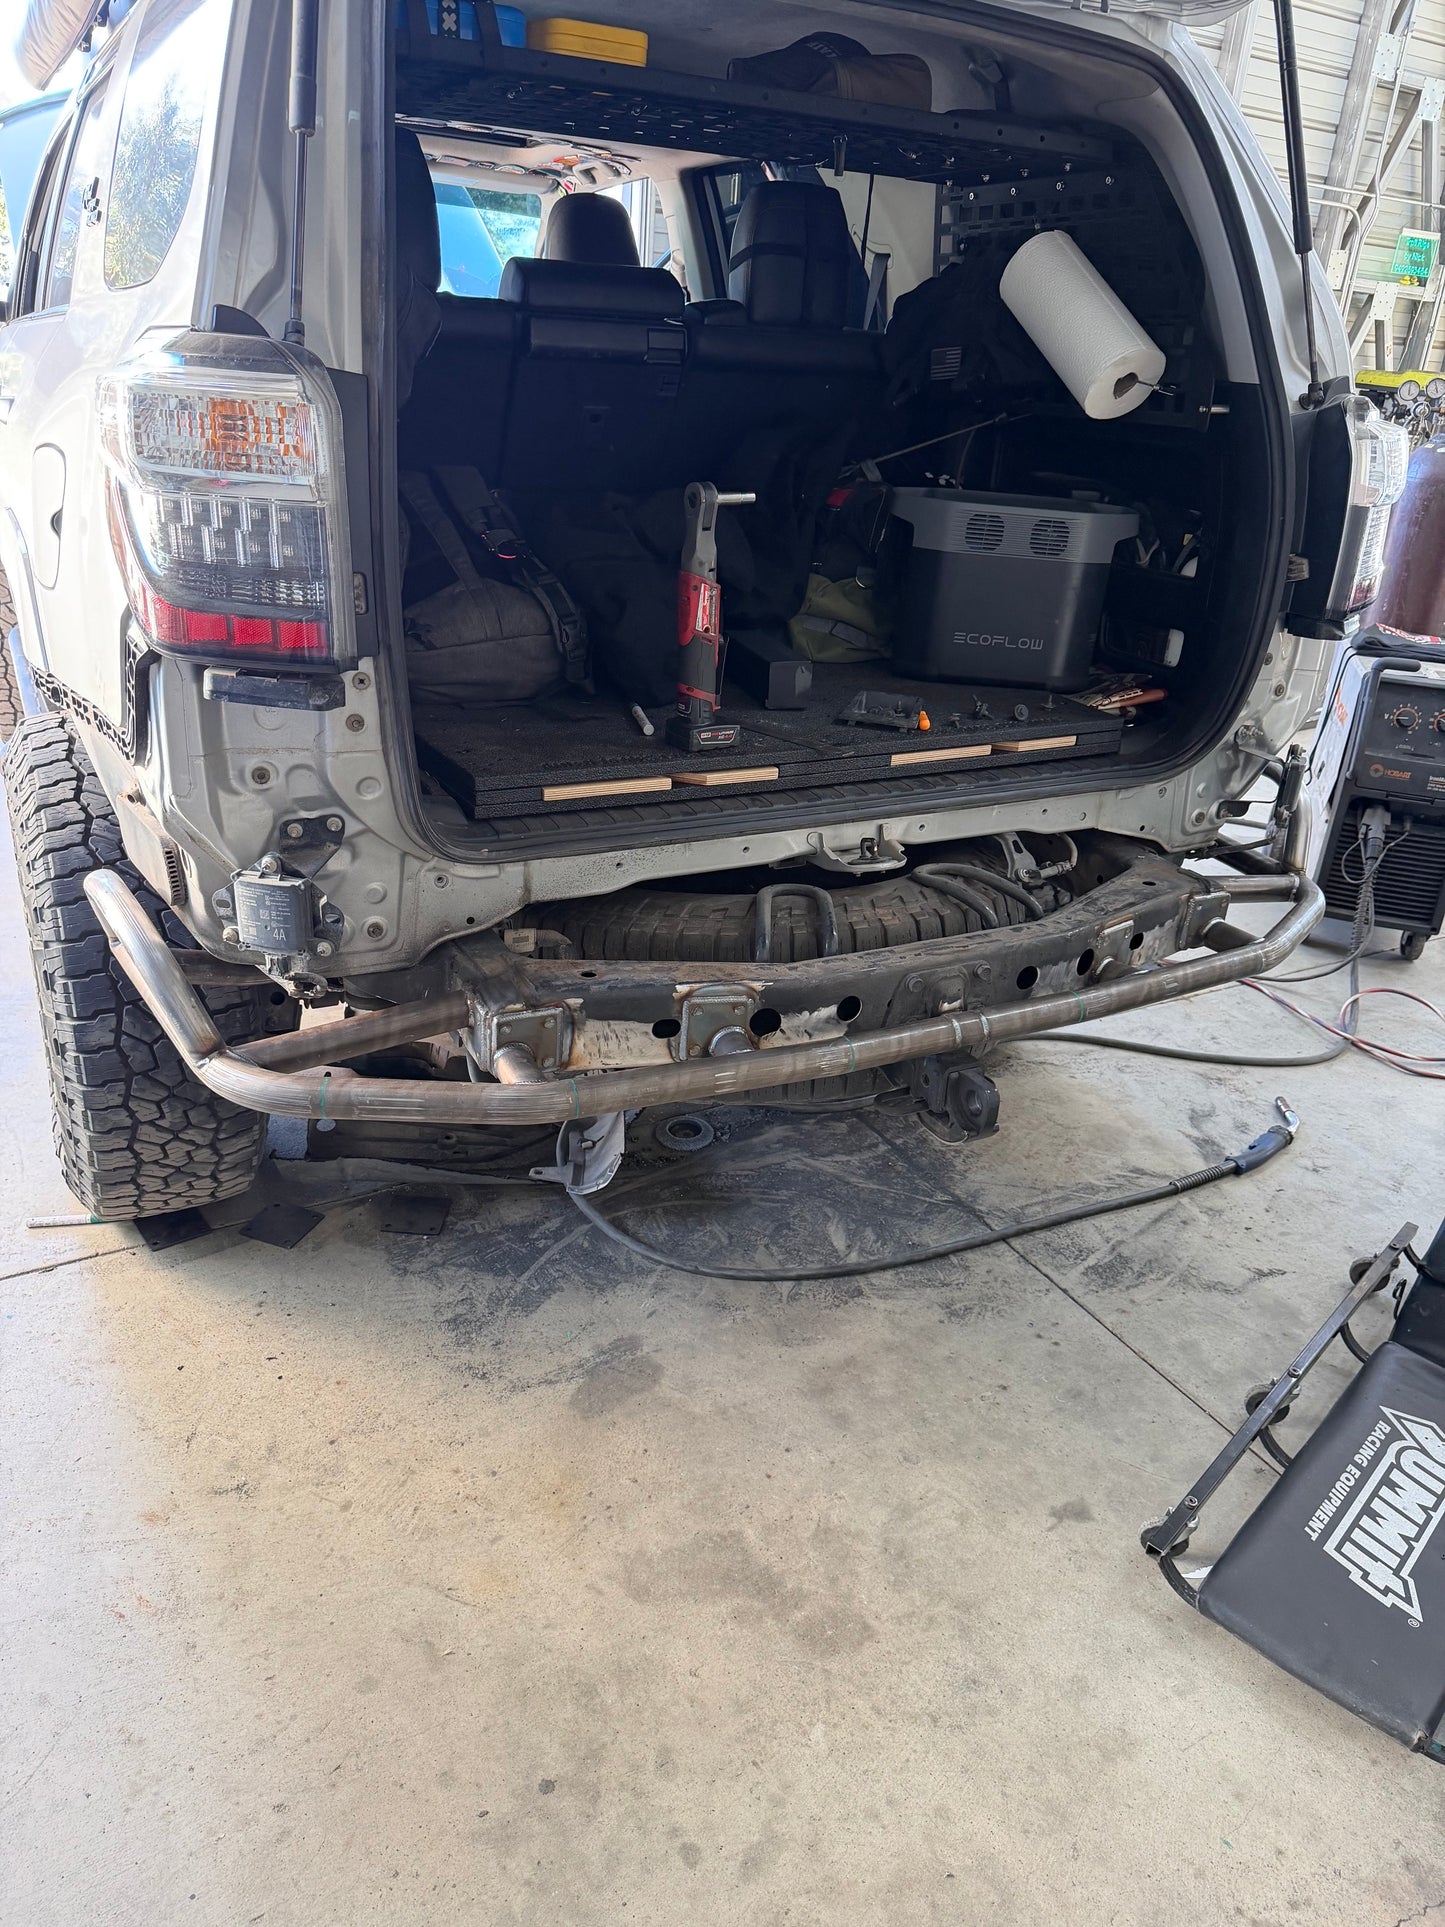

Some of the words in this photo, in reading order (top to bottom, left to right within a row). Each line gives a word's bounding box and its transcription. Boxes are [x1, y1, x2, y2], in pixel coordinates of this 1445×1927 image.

[953, 632, 1044, 650] ECOFLOW
[1384, 769, 1412, 779] HOBART
[273, 928, 286, 941] 4A
[1354, 1420, 1392, 1468] RACING
[1304, 1463, 1362, 1542] EQUIPMENT
